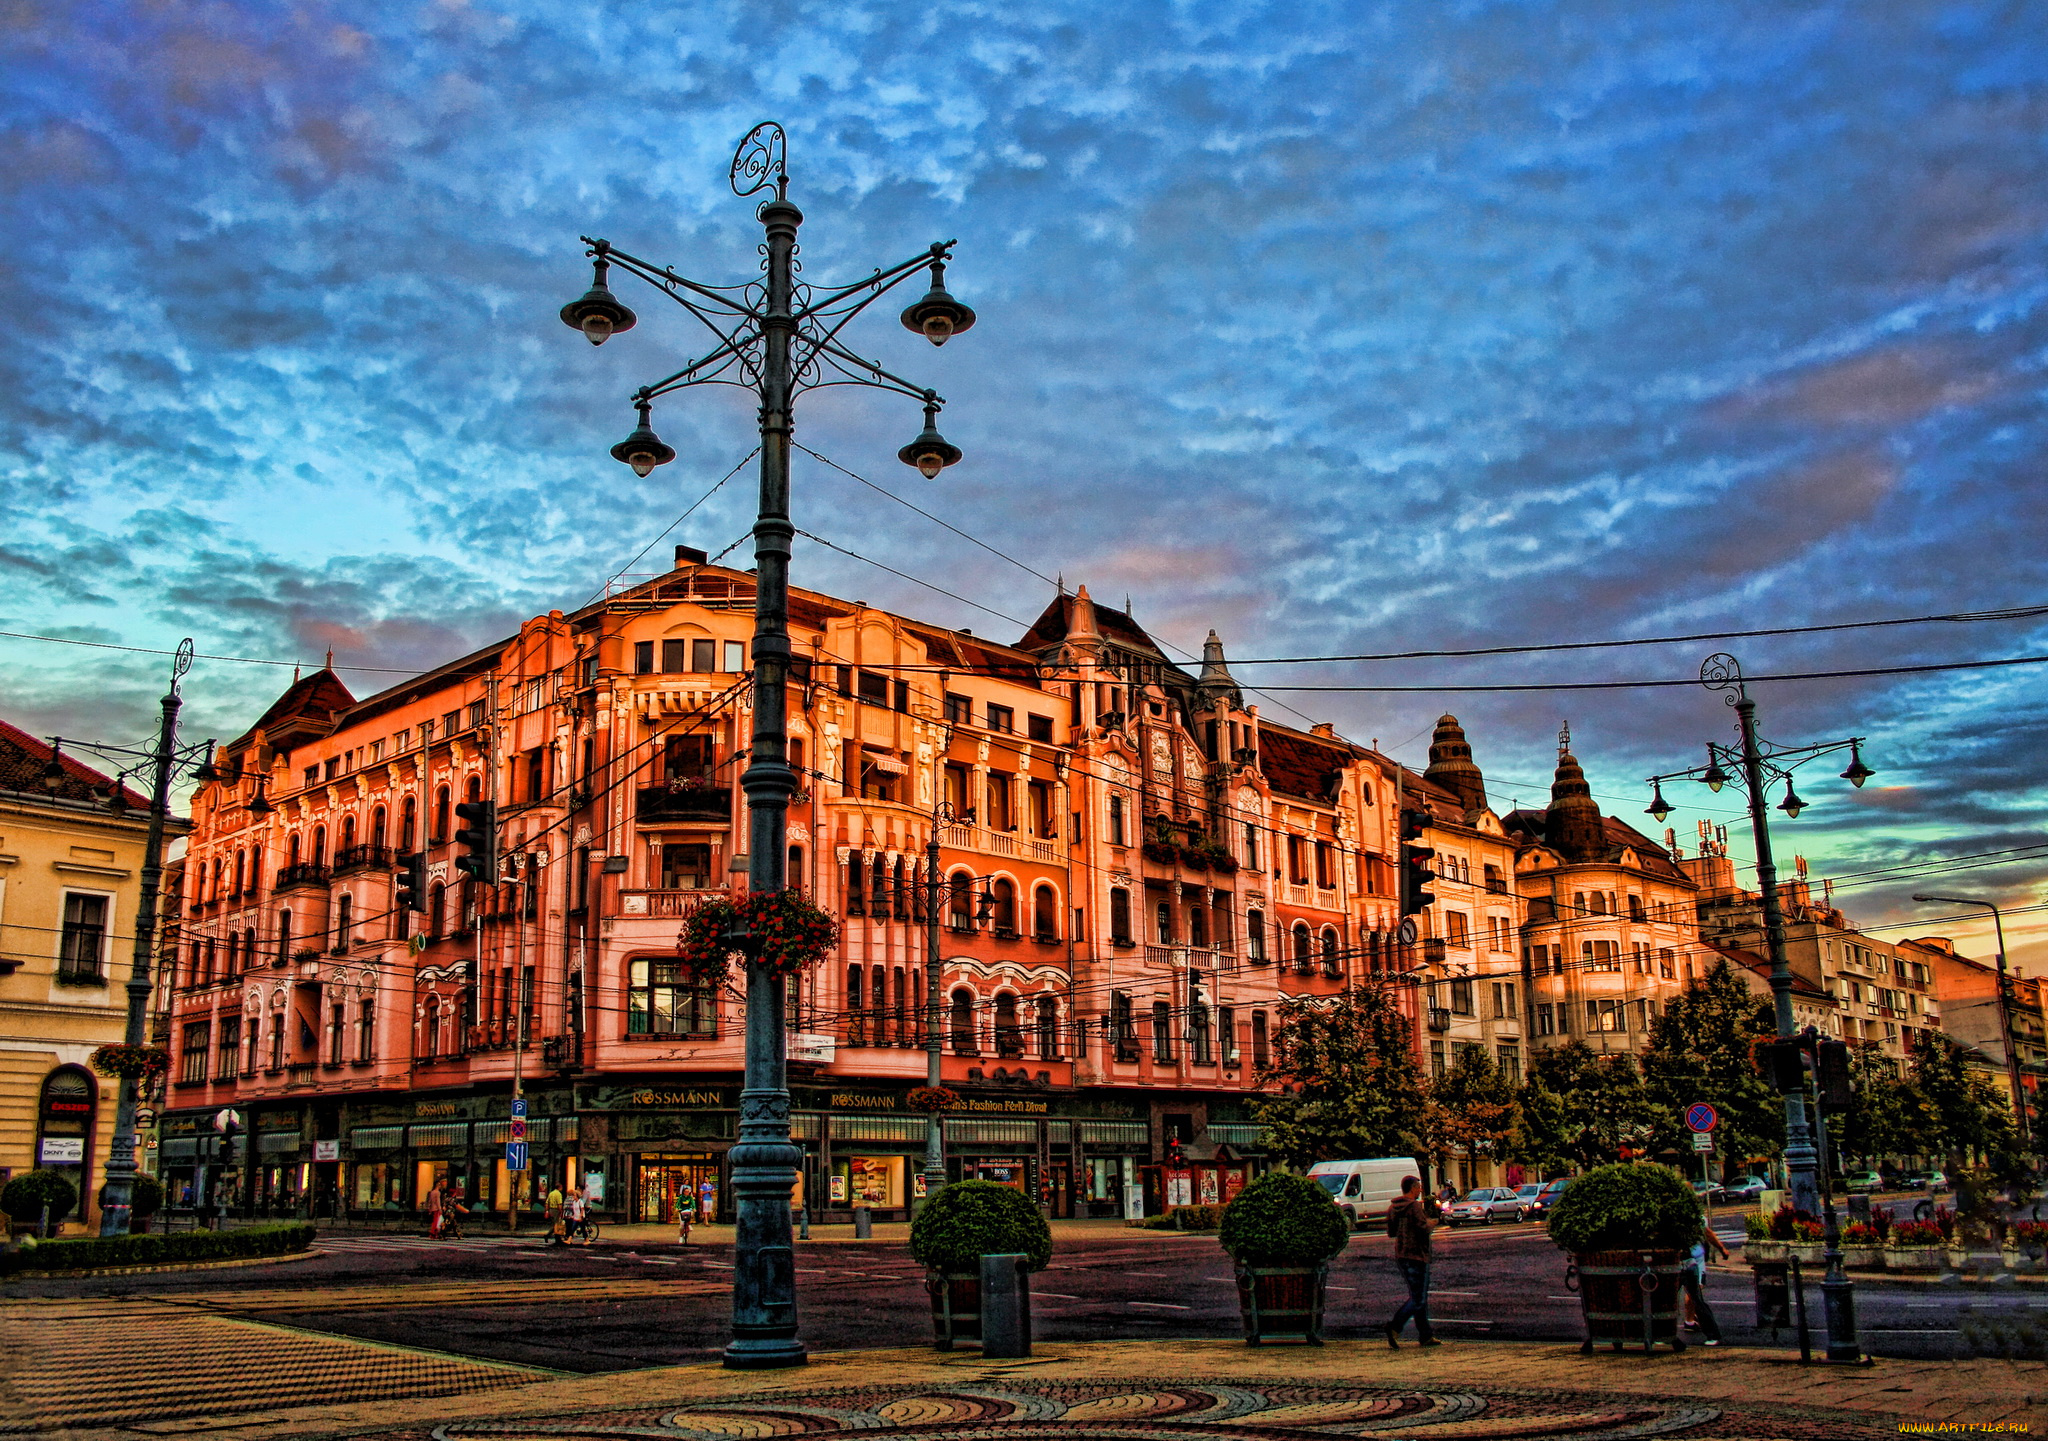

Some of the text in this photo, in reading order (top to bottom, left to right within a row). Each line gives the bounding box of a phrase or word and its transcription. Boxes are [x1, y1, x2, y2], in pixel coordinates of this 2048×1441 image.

[632, 1091, 720, 1104] ROSSMANN
[831, 1094, 895, 1108] ROSSMANN
[516, 1104, 523, 1114] P
[969, 1100, 1003, 1112] Fashion
[1025, 1102, 1048, 1113] Divat
